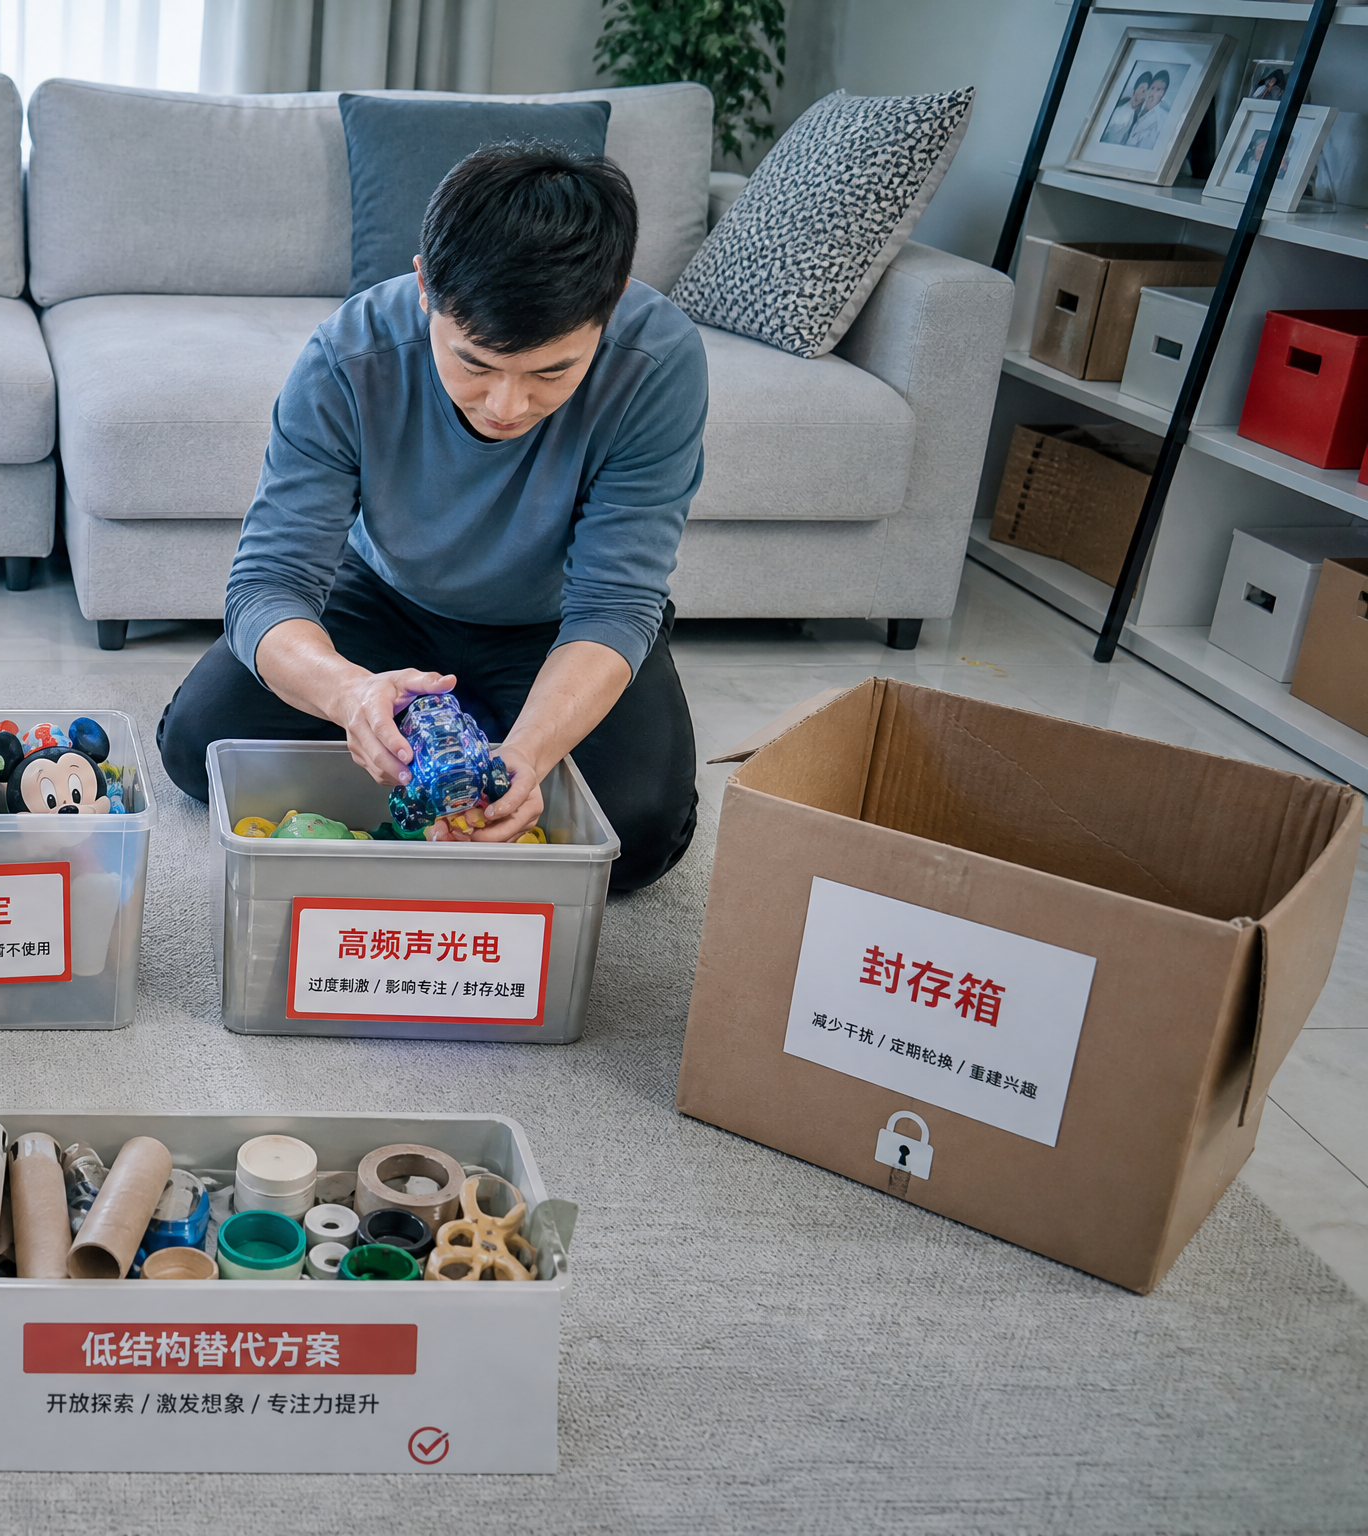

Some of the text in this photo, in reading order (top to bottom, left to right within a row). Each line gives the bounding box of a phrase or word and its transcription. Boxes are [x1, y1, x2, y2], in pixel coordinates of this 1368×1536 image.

[338, 927, 502, 964] 高频声光电
[307, 976, 370, 994] 过度刺激
[385, 979, 448, 996] 影响专注
[462, 980, 526, 998] 封存处理
[859, 944, 1007, 1028] 封存箱
[811, 1011, 875, 1046] 减少干扰
[968, 1063, 1038, 1100] 重建兴趣
[80, 1330, 340, 1368] 低结构替代方案
[46, 1392, 134, 1414] 开放探索
[156, 1392, 245, 1415] 激发想象
[267, 1392, 380, 1415] 专注力提升
